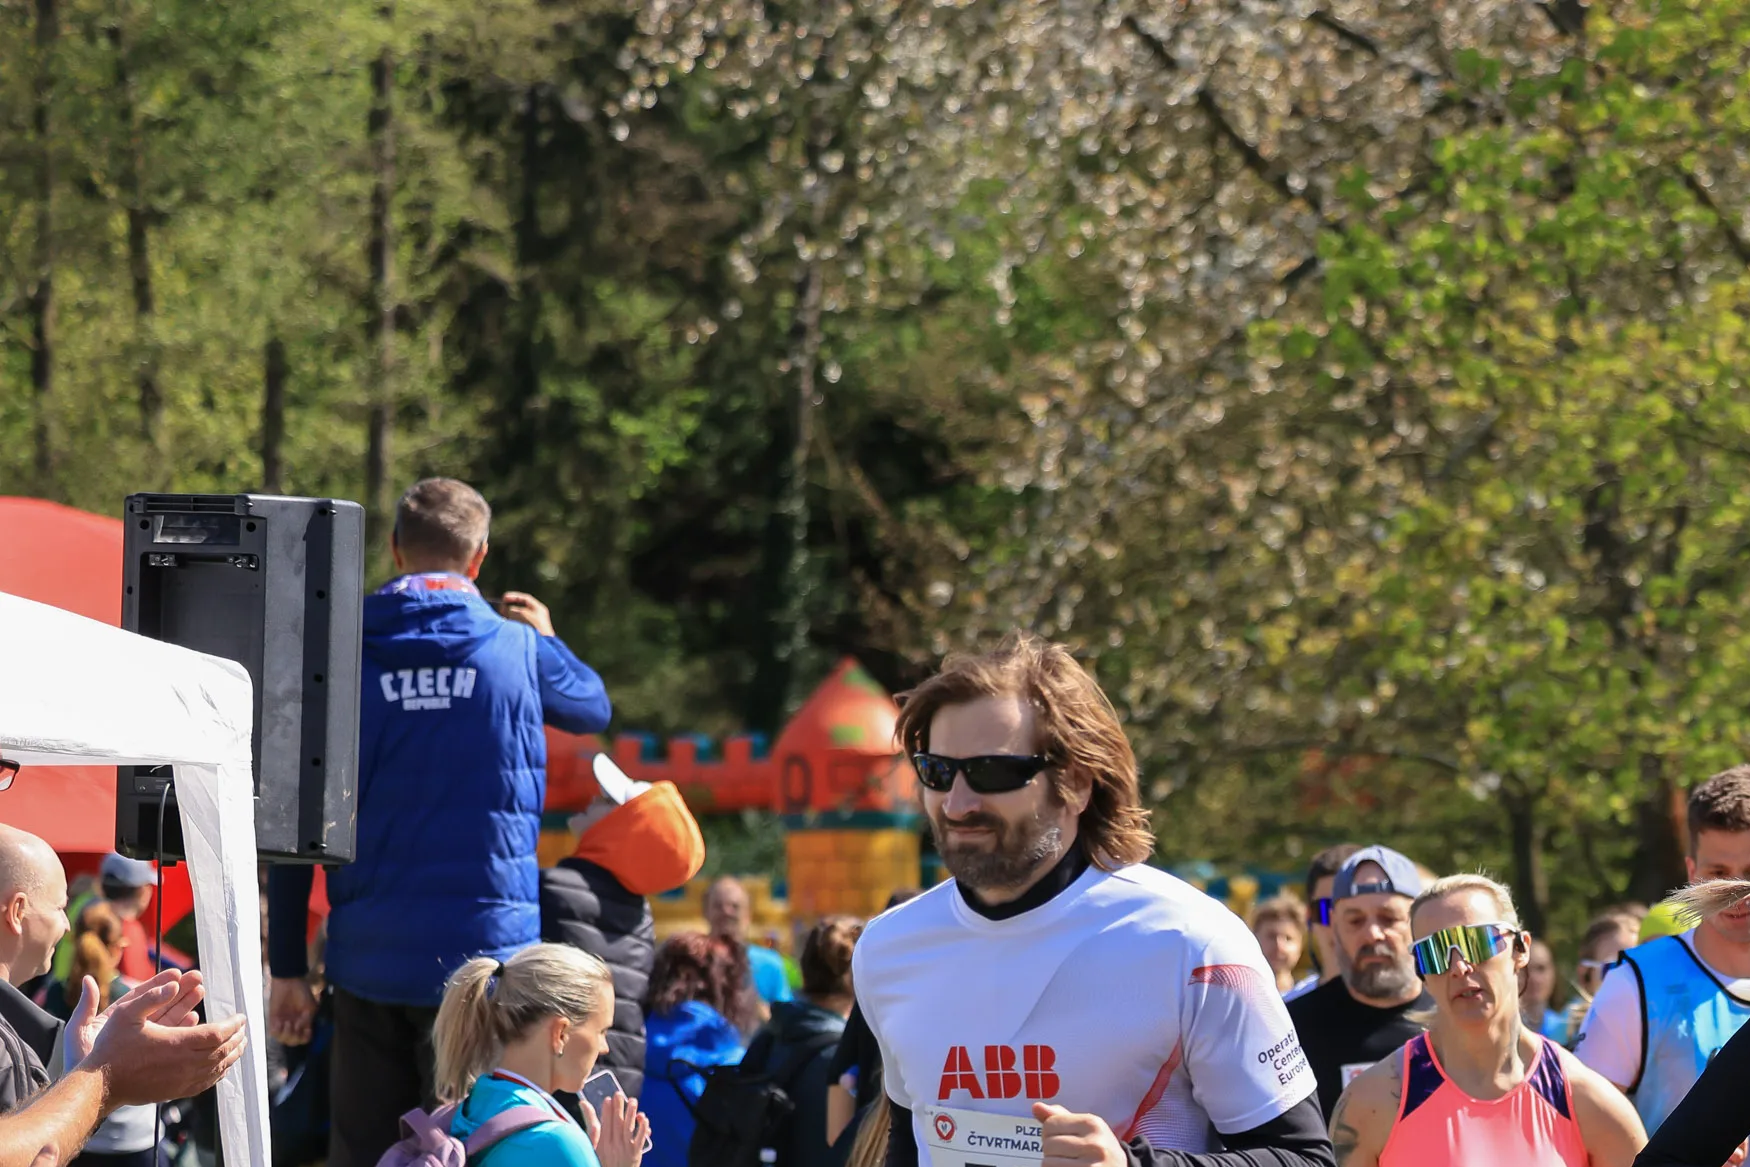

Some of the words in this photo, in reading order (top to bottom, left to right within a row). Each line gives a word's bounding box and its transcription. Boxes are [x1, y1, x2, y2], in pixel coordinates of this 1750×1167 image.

[380, 667, 477, 702] CZECH
[938, 1045, 1060, 1100] ABB
[1015, 1125, 1043, 1137] PLZE
